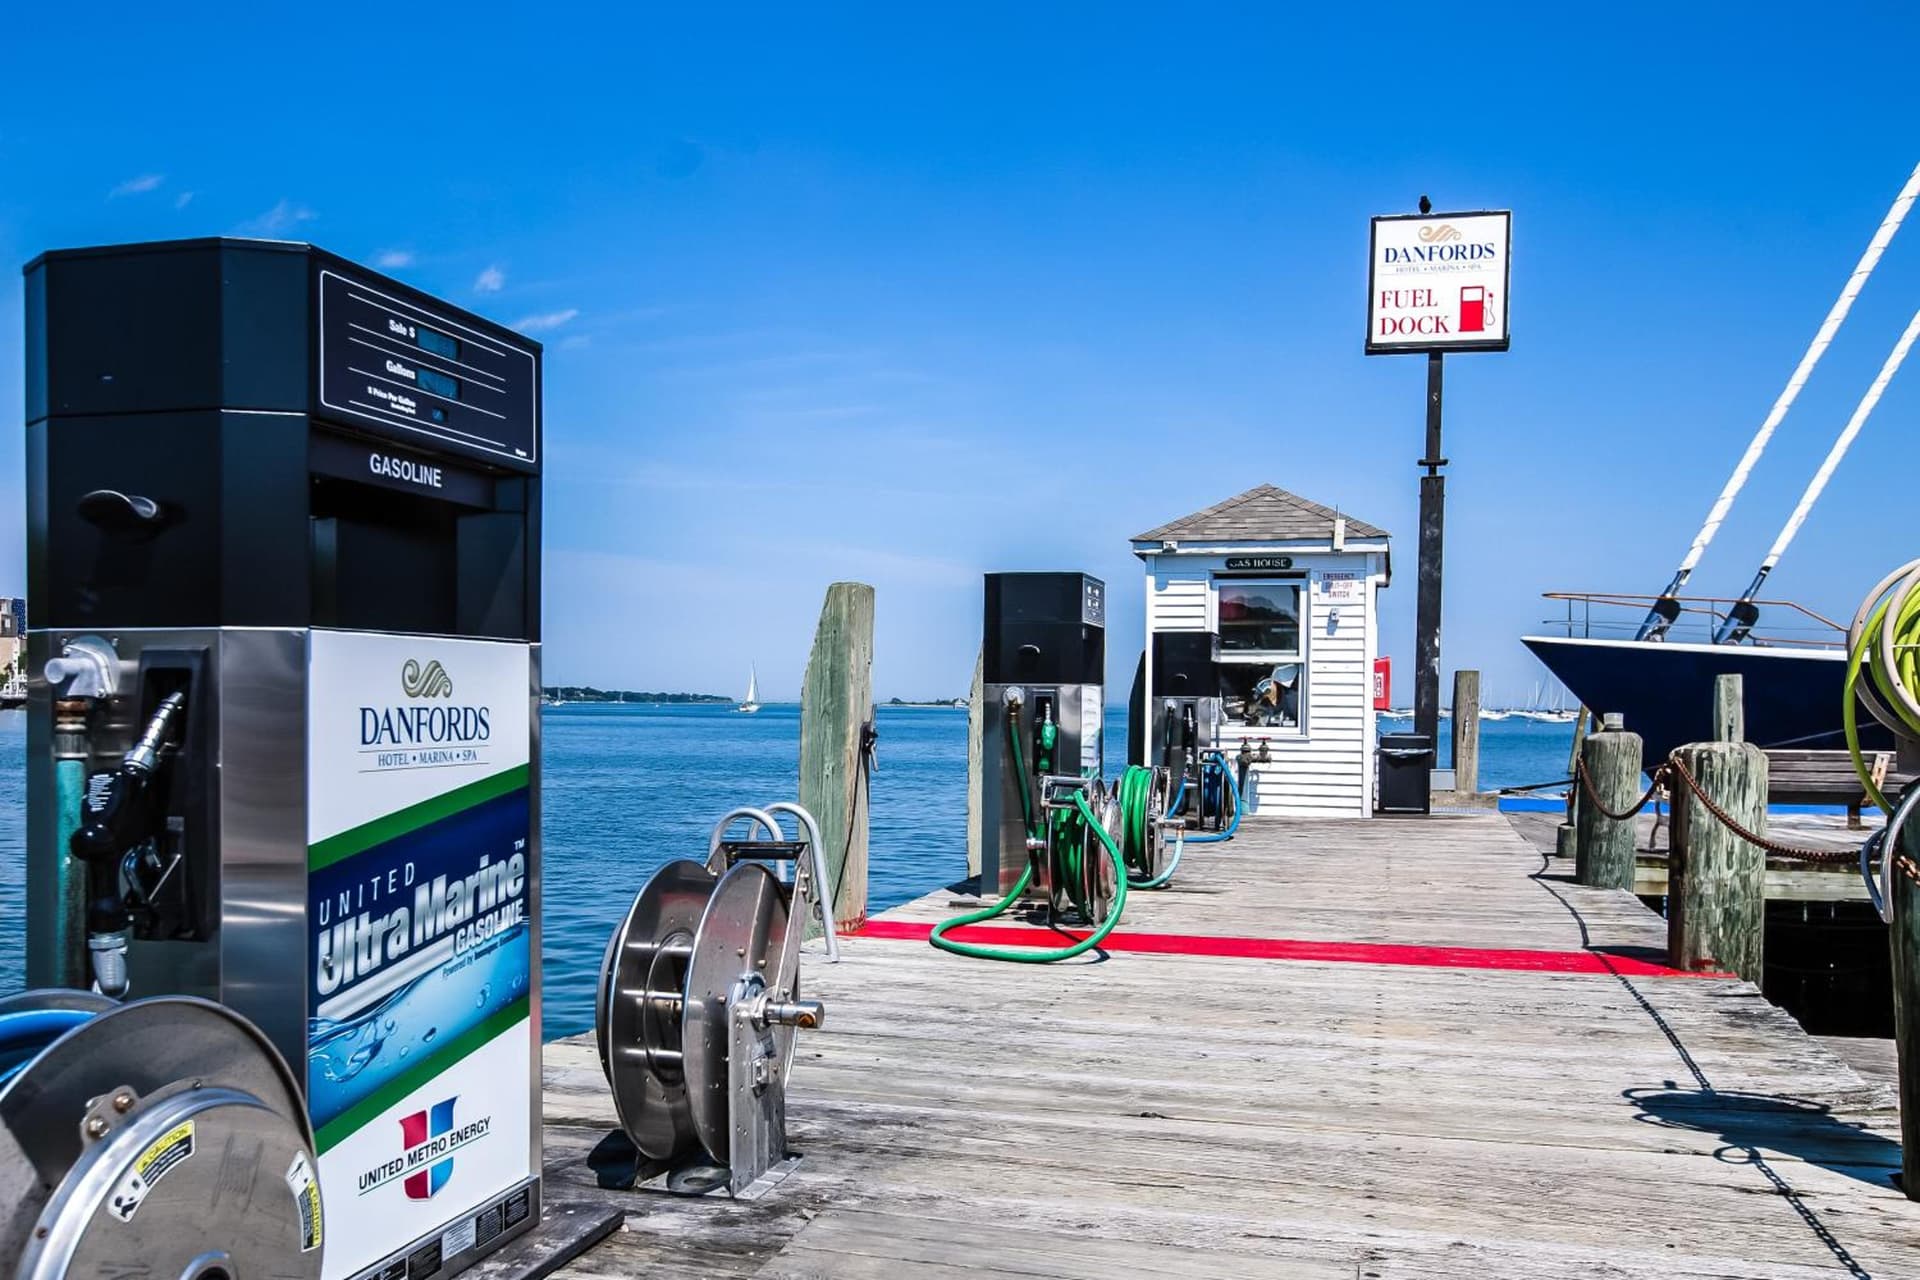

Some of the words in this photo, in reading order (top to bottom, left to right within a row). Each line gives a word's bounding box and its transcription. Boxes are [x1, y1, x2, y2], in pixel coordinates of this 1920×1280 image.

[1385, 242, 1495, 263] DANFORDS
[1380, 288, 1438, 309] FUEL
[389, 319, 408, 336] Sale
[1380, 315, 1450, 336] DOCK
[386, 359, 416, 380] Gallons
[370, 453, 442, 488] GASOLINE
[1230, 558, 1251, 568] GAS
[1253, 558, 1288, 568] HOUSE
[360, 706, 490, 745] DANFORDS
[378, 753, 409, 767] HOTEL
[419, 751, 453, 764] MARINA
[462, 750, 477, 761] SPA
[319, 862, 415, 926] UNITED
[316, 906, 410, 996] Ultra
[413, 853, 525, 947] Marine
[455, 898, 524, 957] GASOLINE
[358, 1158, 404, 1190] UNITED
[407, 1137, 447, 1167] METRO
[449, 1116, 491, 1147] ENERGY
